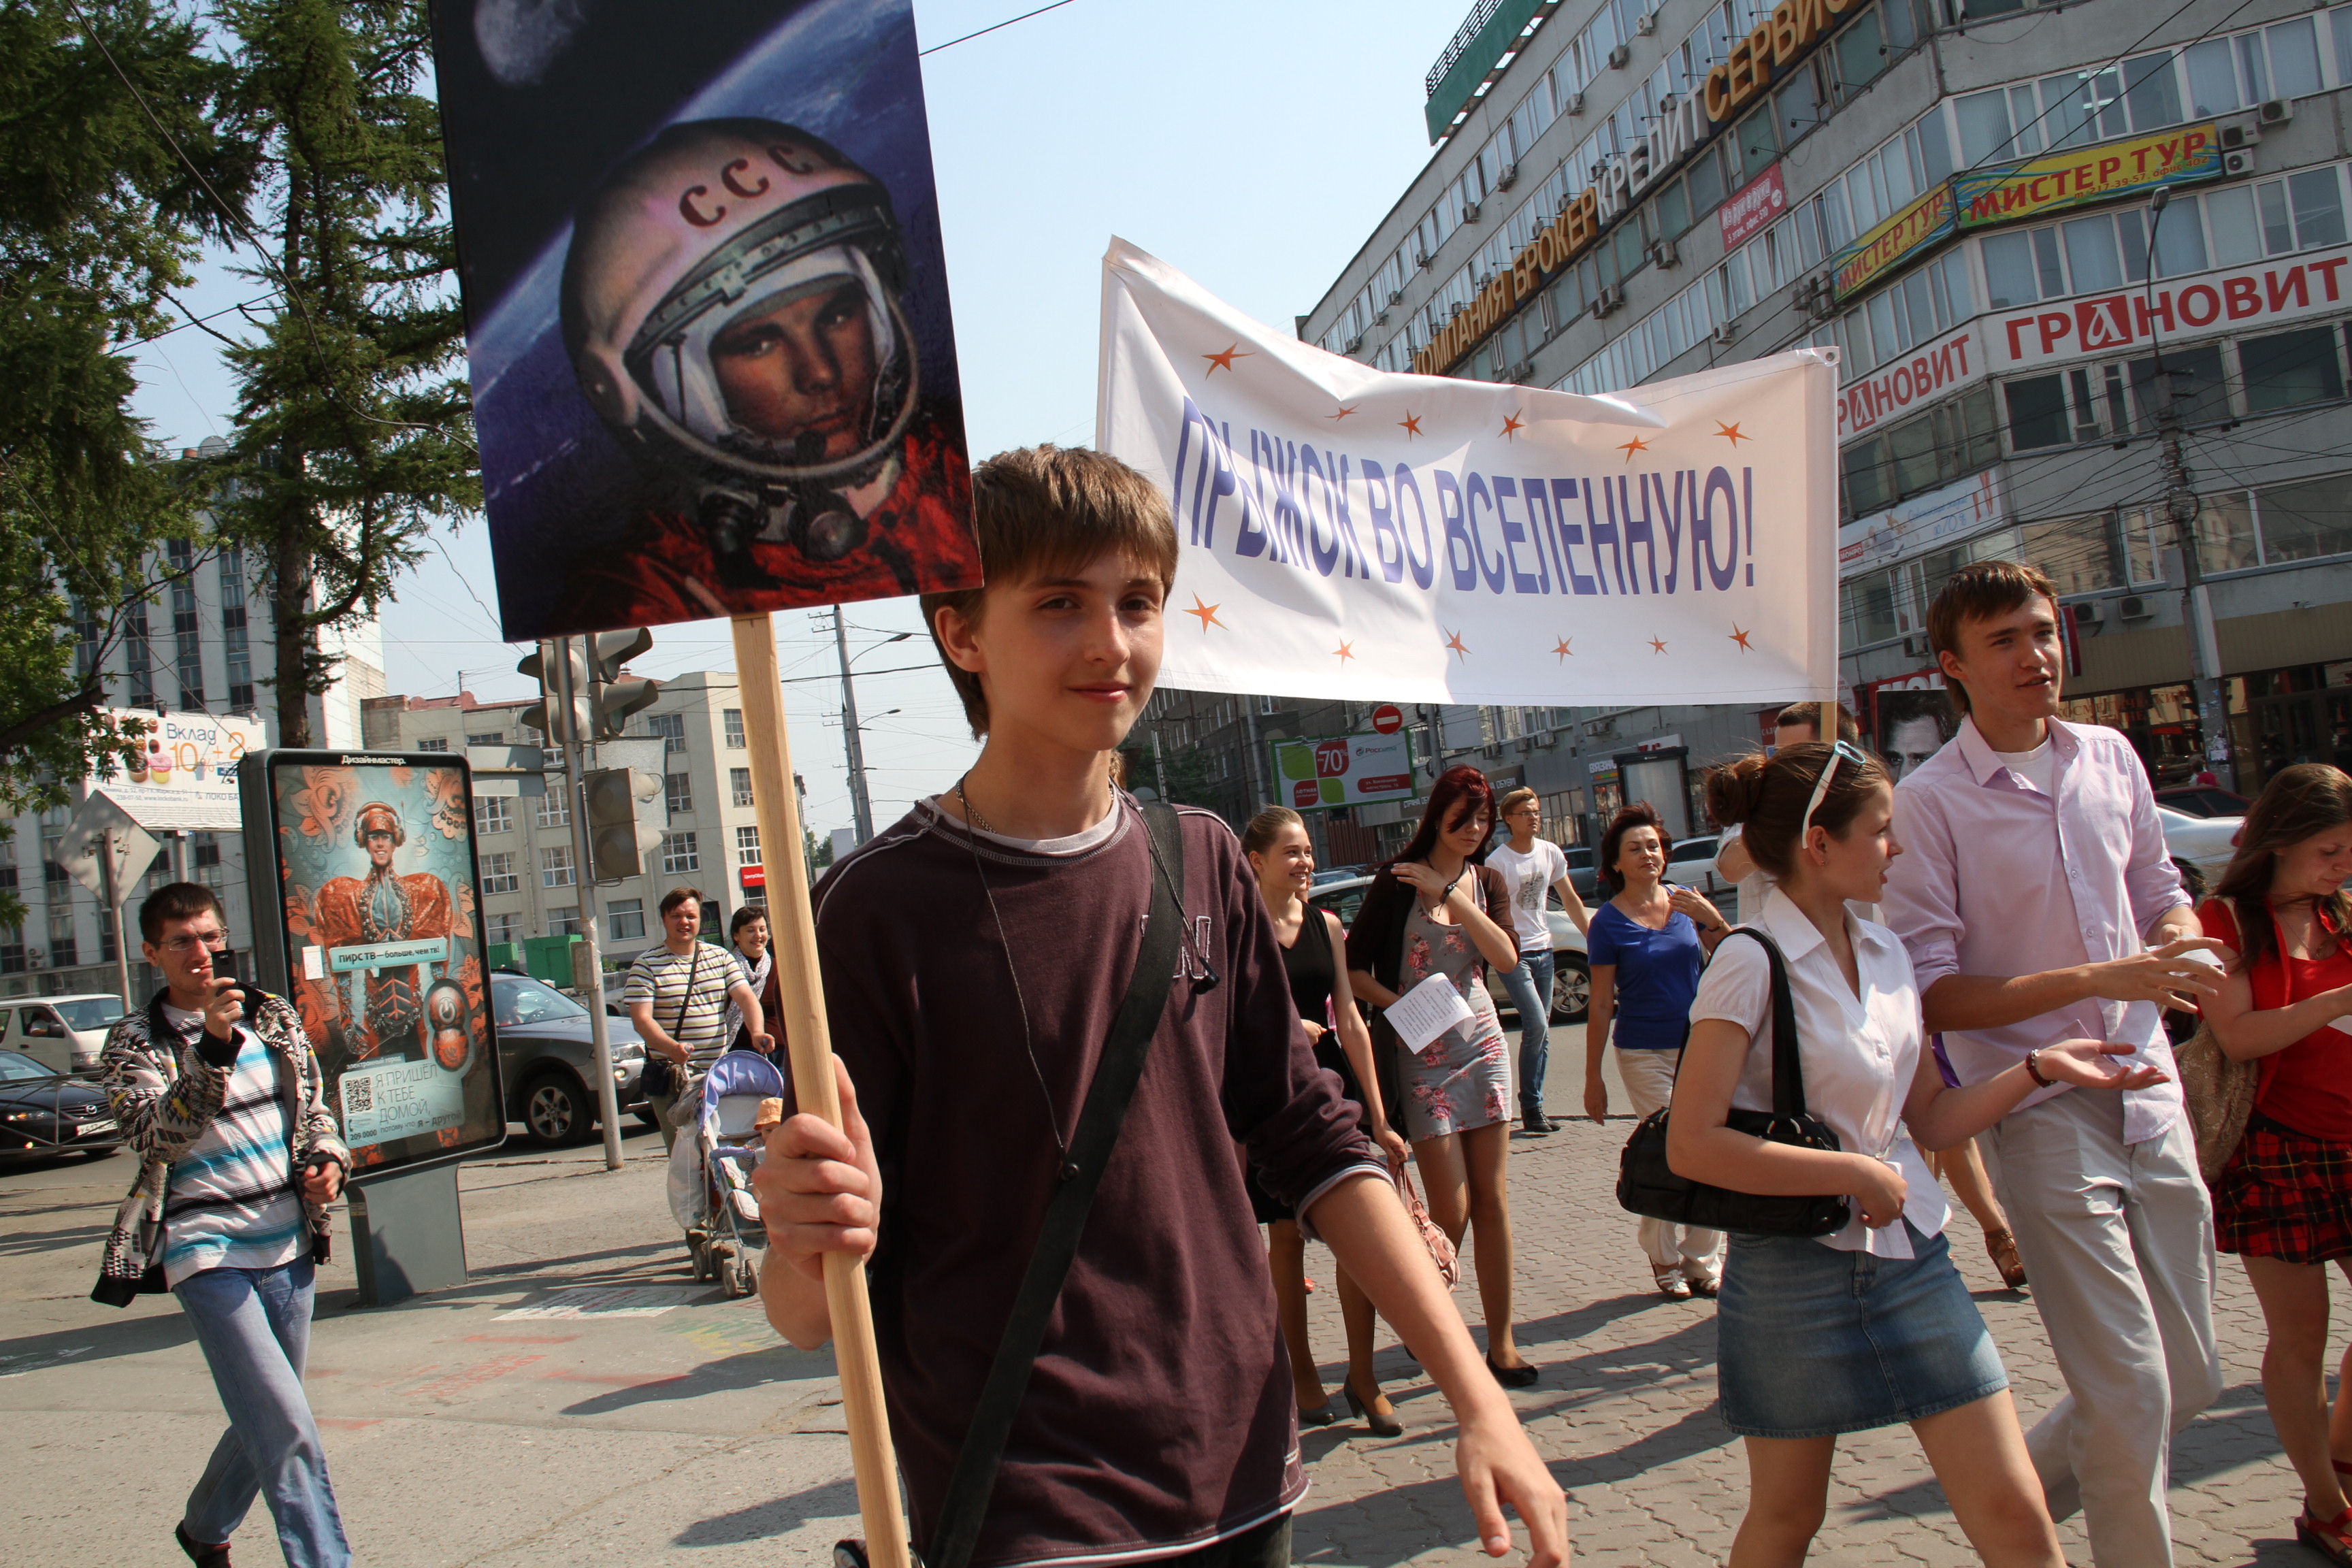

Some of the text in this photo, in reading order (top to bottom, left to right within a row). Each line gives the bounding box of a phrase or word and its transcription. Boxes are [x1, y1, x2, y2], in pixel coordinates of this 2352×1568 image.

[1513, 186, 1598, 301] БРОКЕР
[1595, 80, 1710, 226] КРЕДИТ
[1704, 0, 1858, 123] СЕРВИ
[1969, 132, 2207, 222] МИСТЕР ТУР
[2153, 163, 2183, 180] офис
[2187, 154, 2209, 168] 402
[678, 143, 815, 228] ССС
[1838, 192, 1944, 296] МИСТЕР ТУР
[2004, 255, 2349, 361] ГРАНОВИТ
[1838, 333, 1970, 437] РАНОВИТ
[1173, 395, 1754, 595] ПРЫЖОК ВО ВСЕЛЕННУЮ!
[166, 723, 217, 745] Вклад
[341, 755, 407, 766] Дизайнмастер.
[339, 952, 363, 965] пирс
[376, 1062, 438, 1088] Я ПРИШЁЛ
[377, 1085, 416, 1106] К ТЕБЕ
[380, 1098, 431, 1126] ДОМОЙ,
